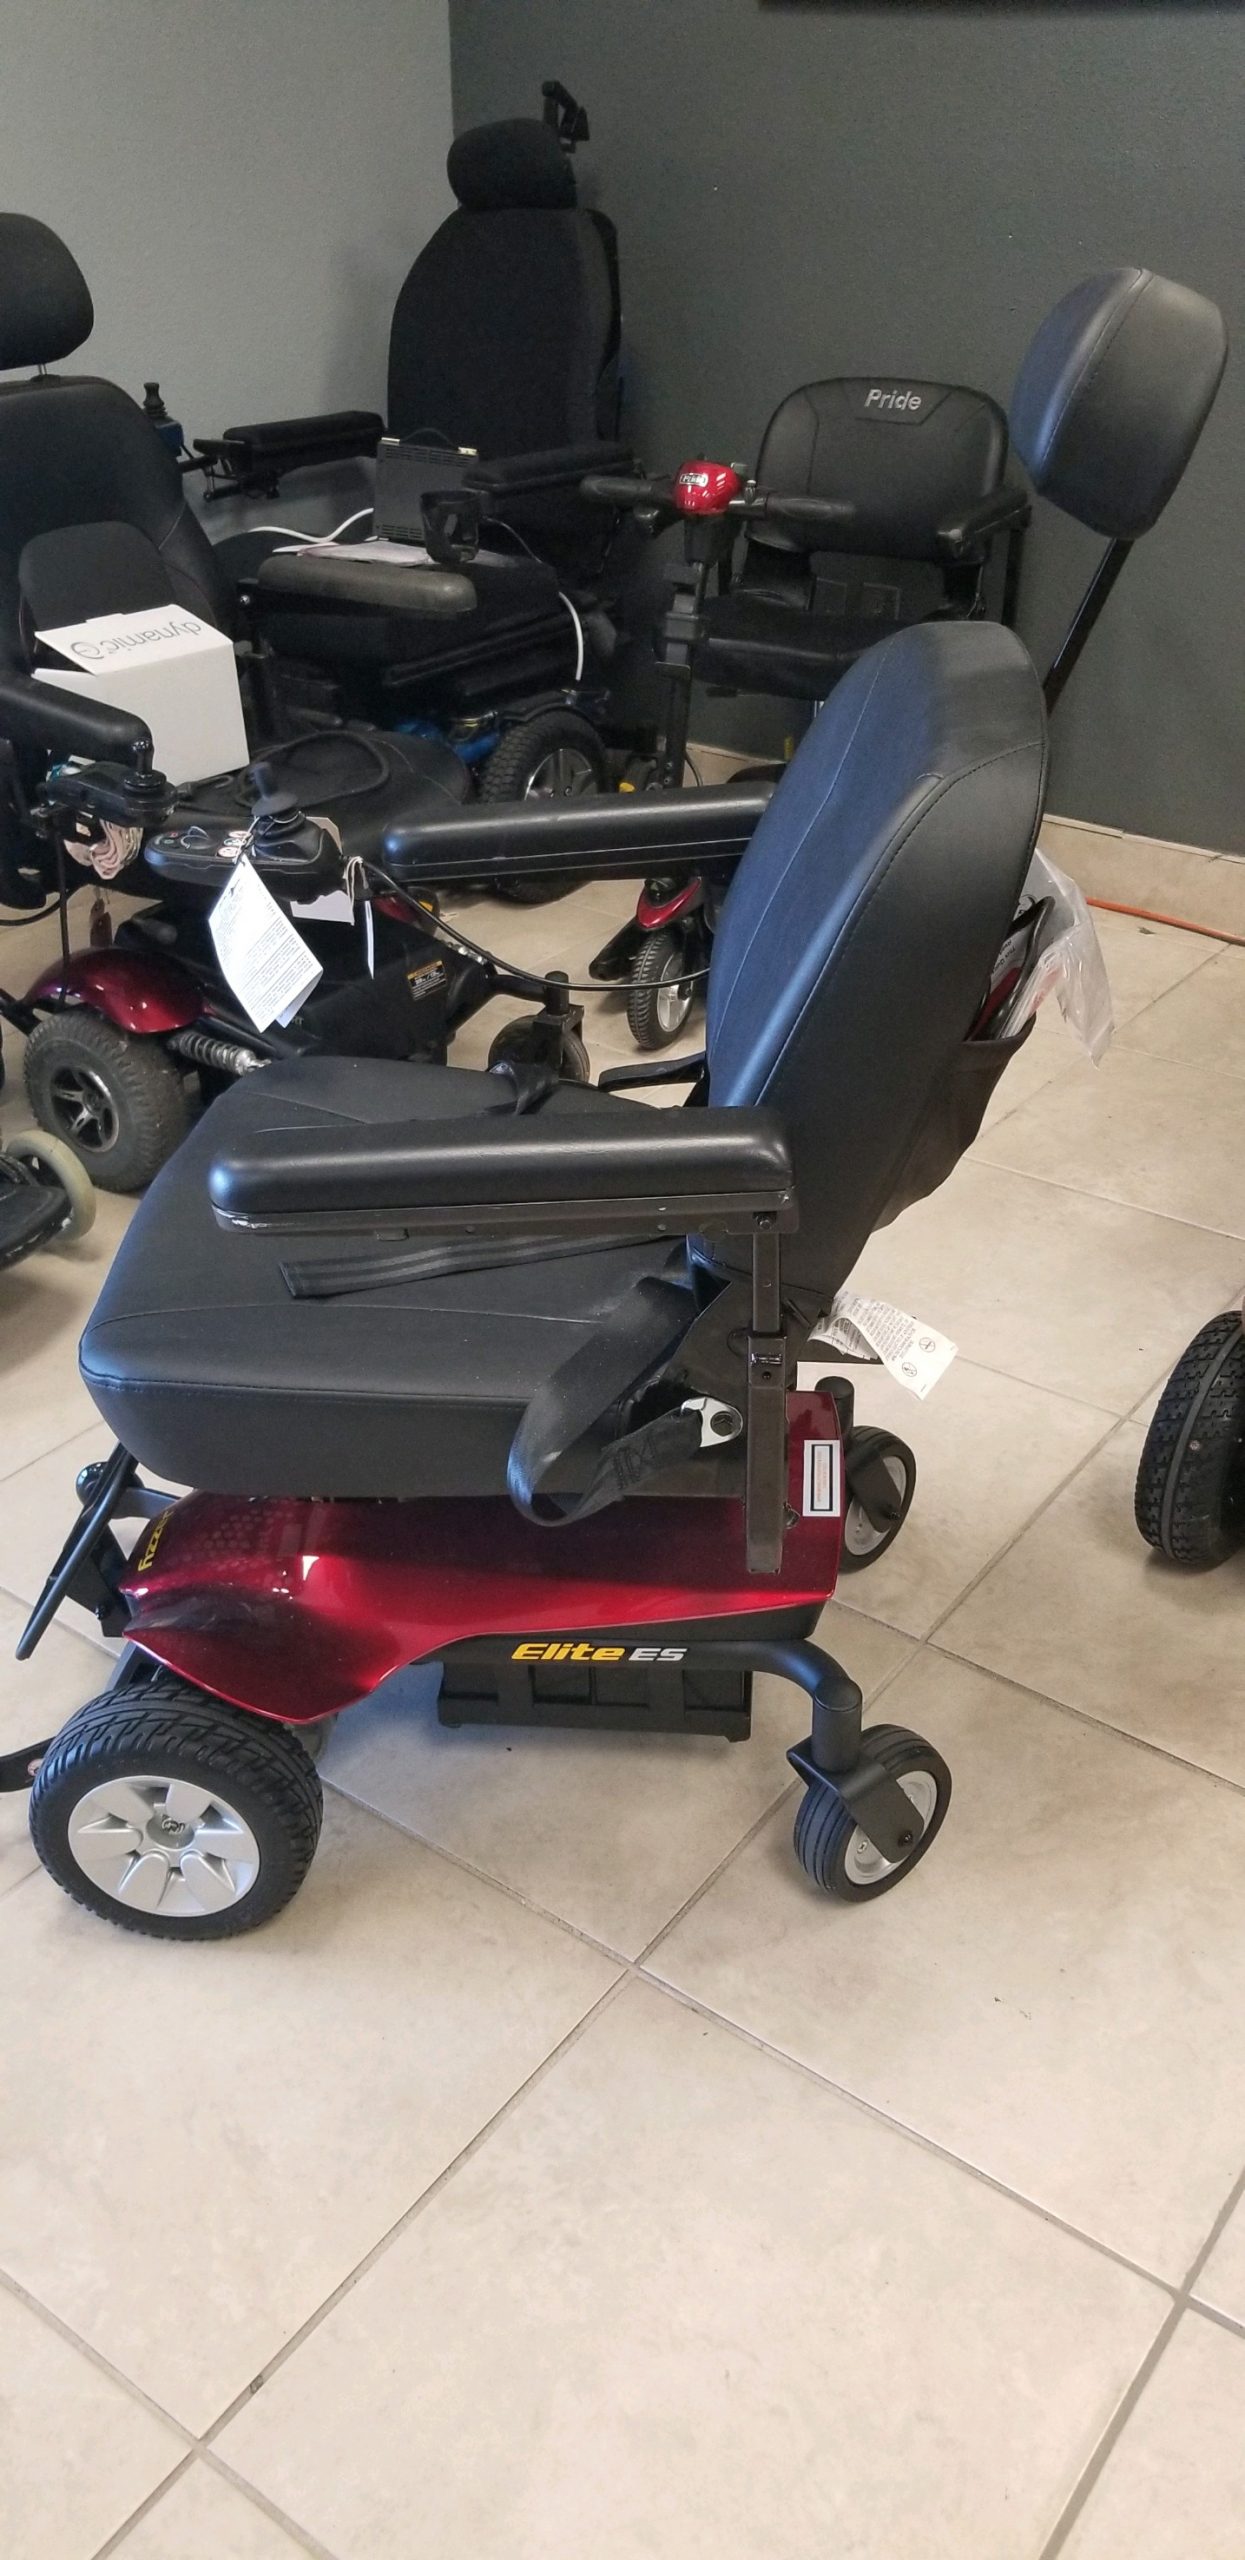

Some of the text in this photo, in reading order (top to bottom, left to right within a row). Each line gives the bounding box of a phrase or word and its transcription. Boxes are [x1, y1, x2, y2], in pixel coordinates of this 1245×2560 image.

[864, 388, 922, 411] Pride
[100, 621, 201, 651] dynamic
[511, 1642, 688, 1662] Elite ES
